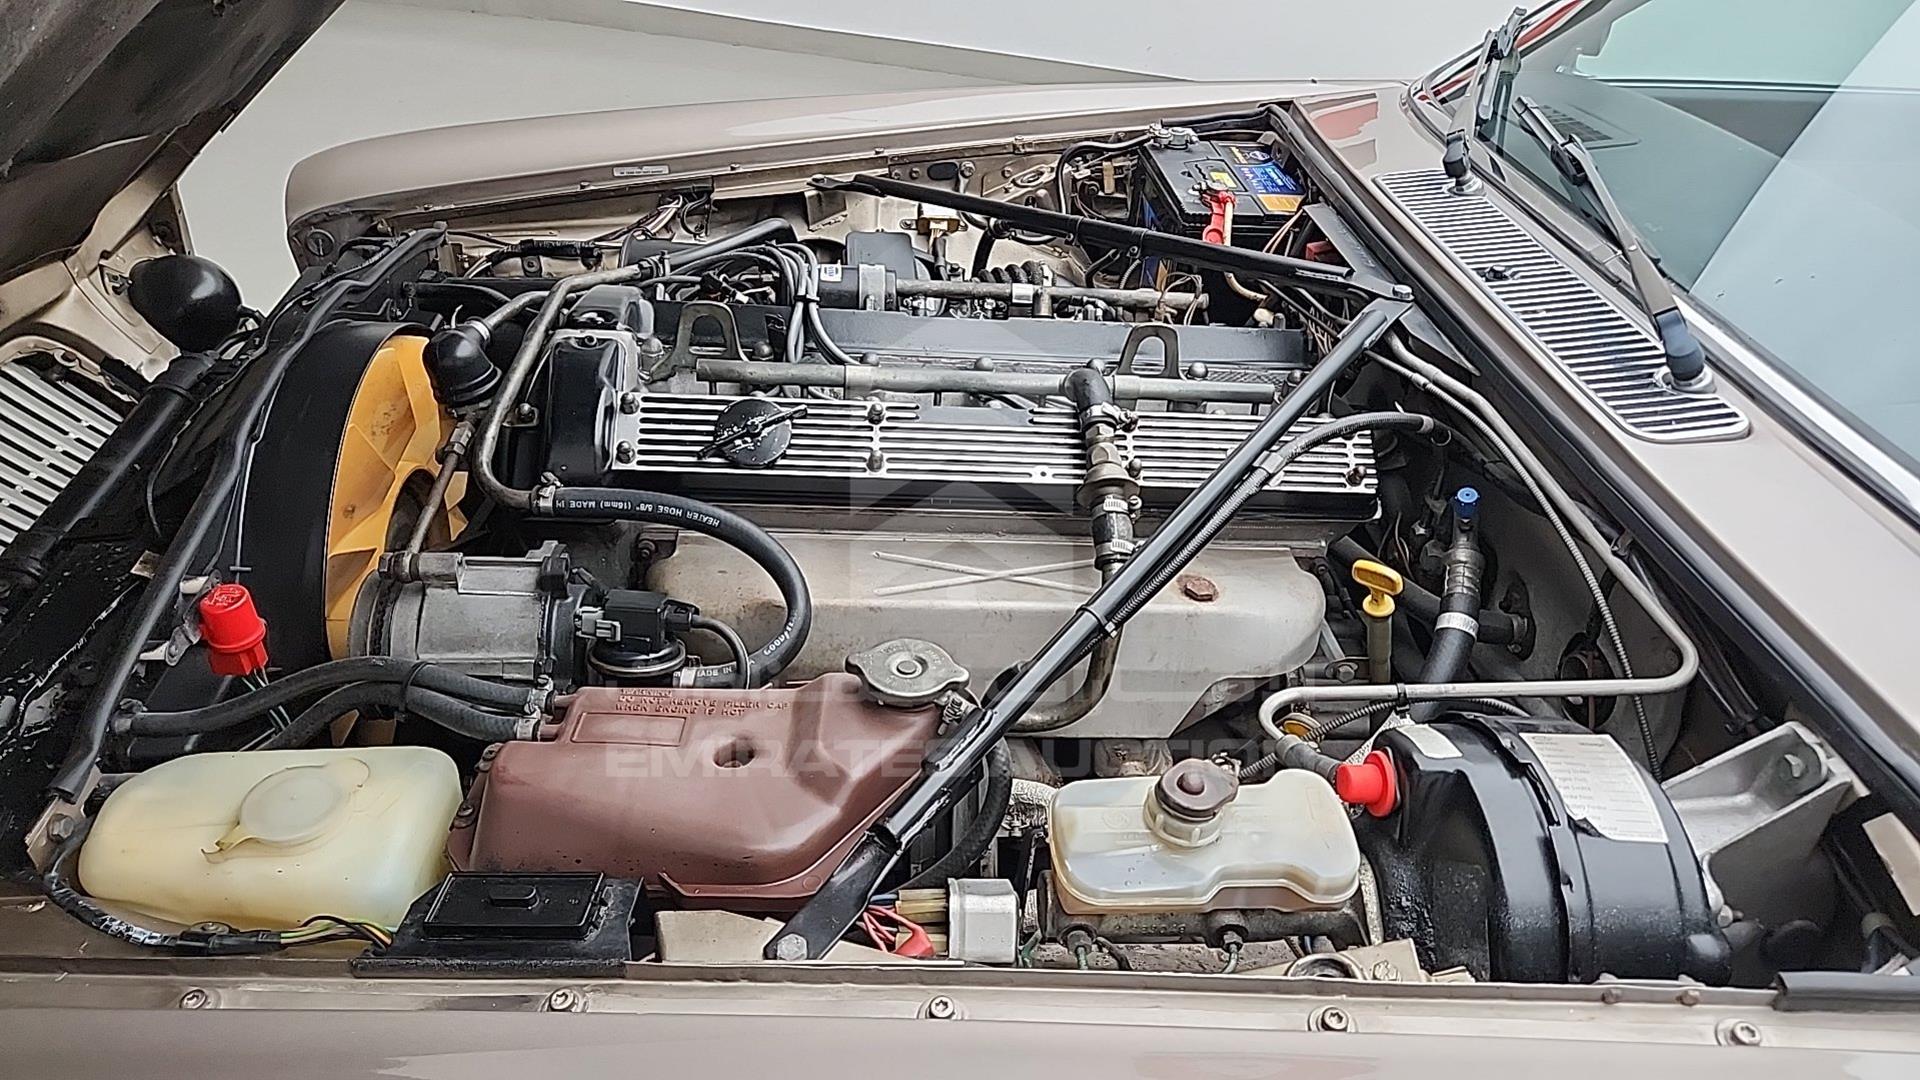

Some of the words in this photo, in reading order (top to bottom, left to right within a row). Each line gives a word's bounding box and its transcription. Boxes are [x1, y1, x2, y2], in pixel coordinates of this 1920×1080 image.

[569, 500, 596, 509] MADE
[657, 505, 682, 517] HOSE
[687, 509, 720, 528] HEATER
[723, 666, 733, 674] IN
[640, 697, 665, 705] NOT
[669, 698, 717, 707] REMOVE
[723, 700, 760, 709] FILLER
[766, 702, 790, 710] CAP
[615, 703, 648, 712] WHEN
[654, 705, 697, 715] ENGINE
[721, 708, 746, 717] HOT
